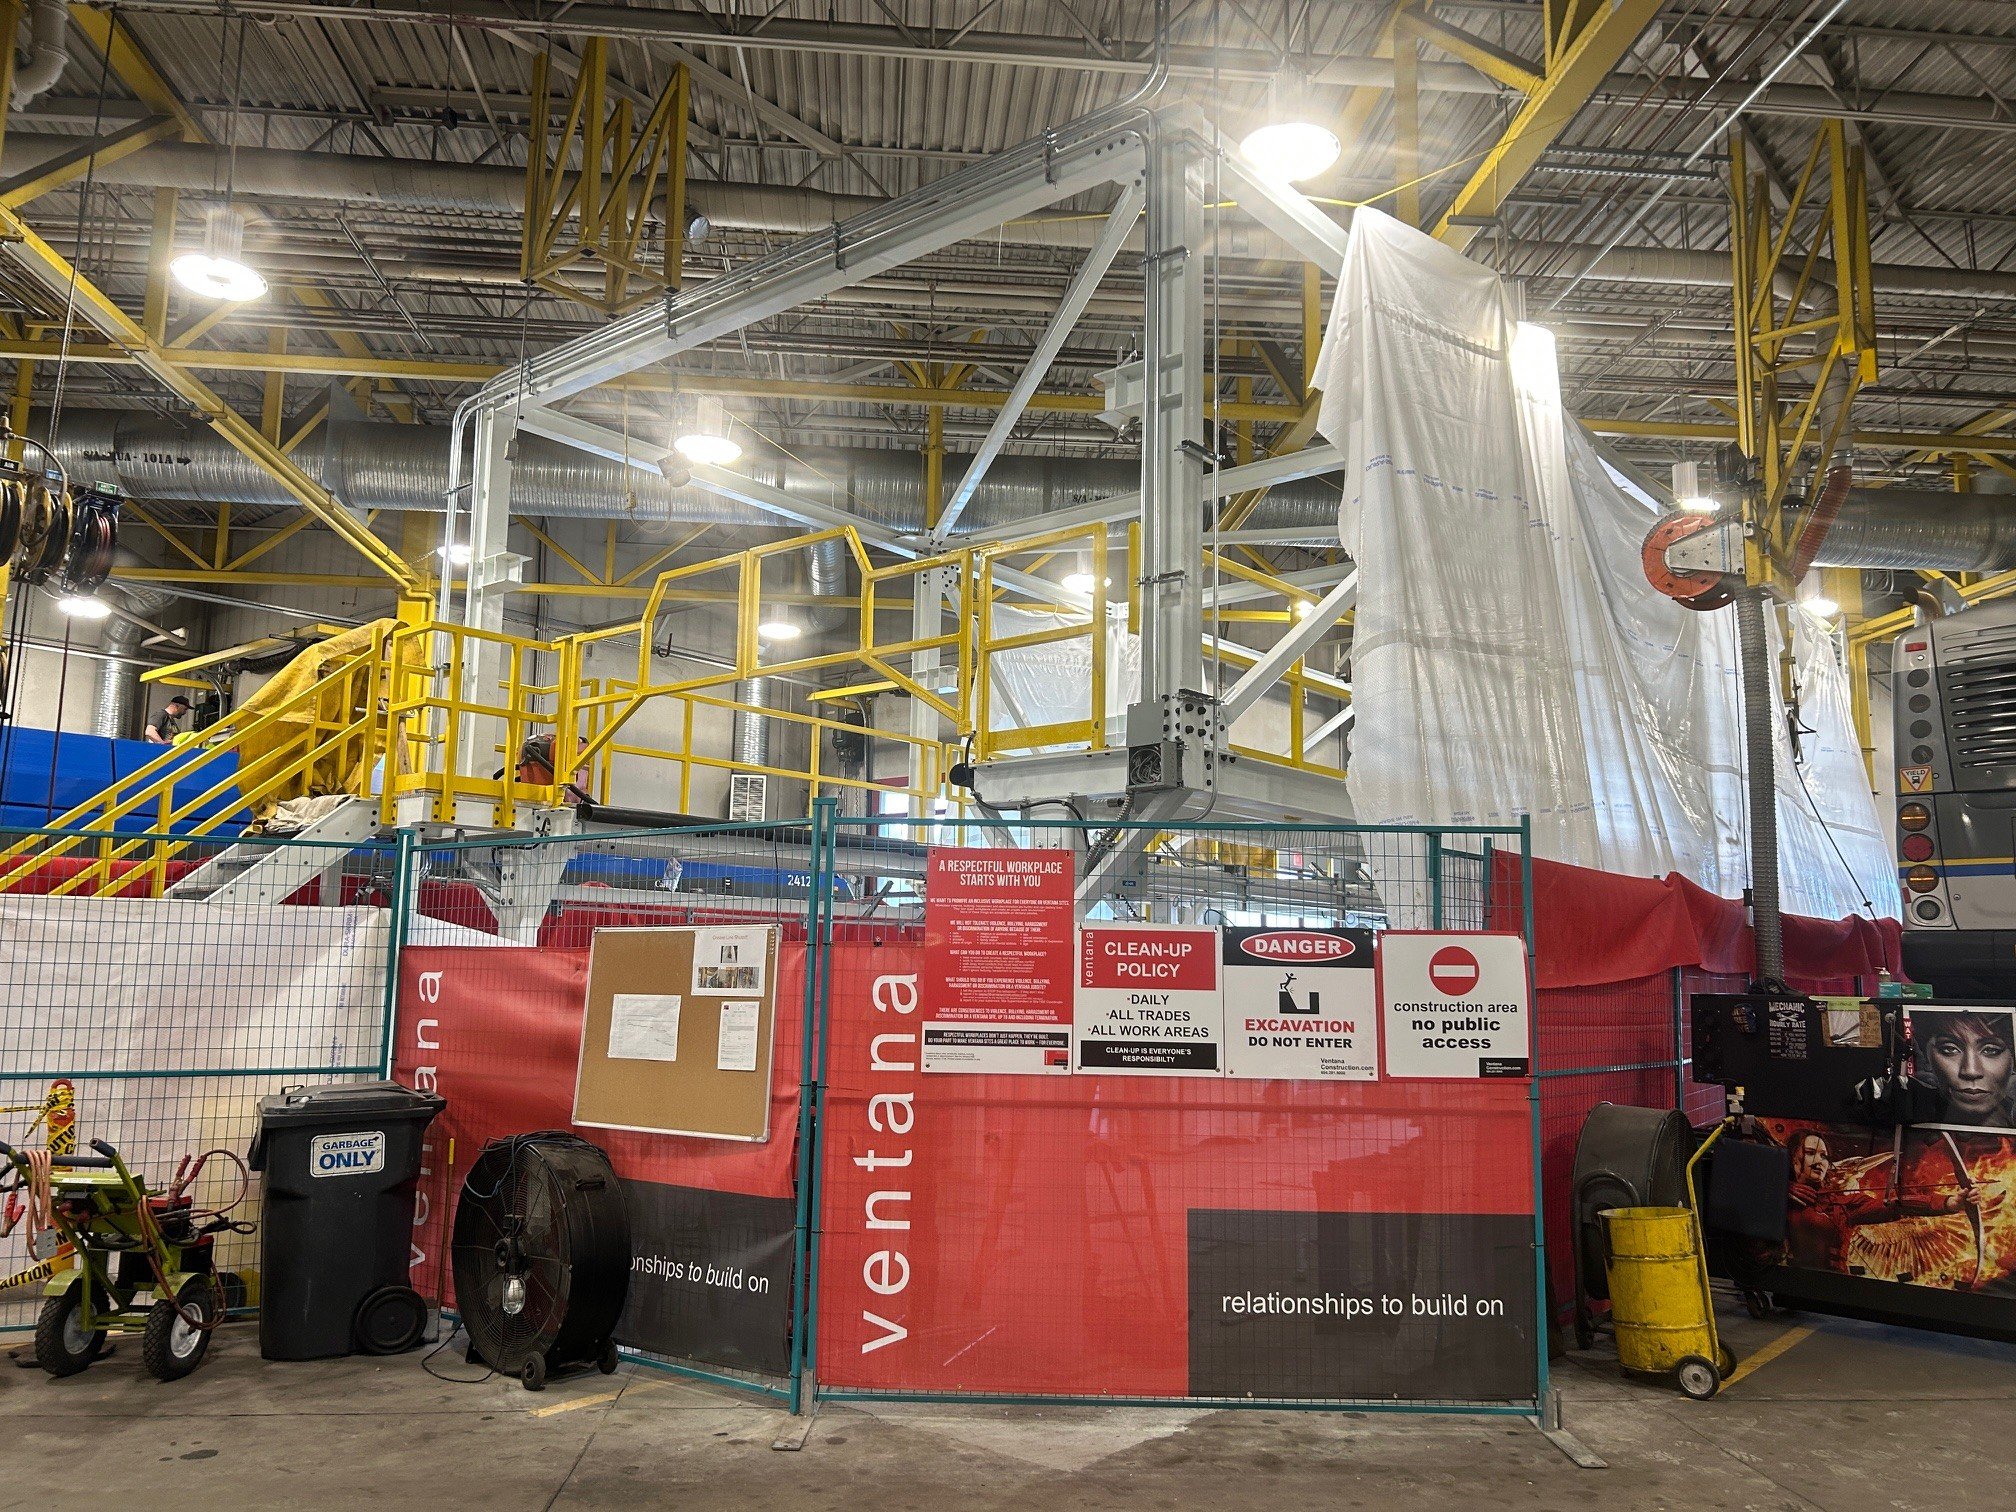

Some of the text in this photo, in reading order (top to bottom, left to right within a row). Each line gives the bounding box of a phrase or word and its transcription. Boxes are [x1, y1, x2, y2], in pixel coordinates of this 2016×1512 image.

[144, 453, 173, 464] 101A
[939, 860, 1062, 874] A RESPECTFUL WORKPLACE
[960, 874, 1041, 887] STARTS WITH YOU
[1104, 942, 1192, 957] CLEAN-UP
[1255, 939, 1342, 955] DANGER
[1086, 932, 1094, 986] ventana
[1117, 963, 1181, 978] POLICY
[1394, 1001, 1518, 1013] construction area
[1769, 1002, 1805, 1013] MECHANIC
[1138, 1010, 1190, 1021] TRADES
[1120, 1026, 1160, 1037] WORK
[1164, 1027, 1209, 1038] AREAS
[1245, 1019, 1355, 1033] EXCAVATION
[1412, 1018, 1500, 1034] no public
[1249, 1037, 1352, 1048] DO NOT ENTER
[1423, 1038, 1491, 1049] access
[323, 1140, 374, 1150] GARBAGE
[319, 1150, 376, 1170] ONLY
[853, 973, 918, 1354] ventana
[688, 1262, 702, 1282] to
[706, 1264, 743, 1289] build
[748, 1275, 769, 1294] on
[1222, 1291, 1504, 1319] relationships to build on
